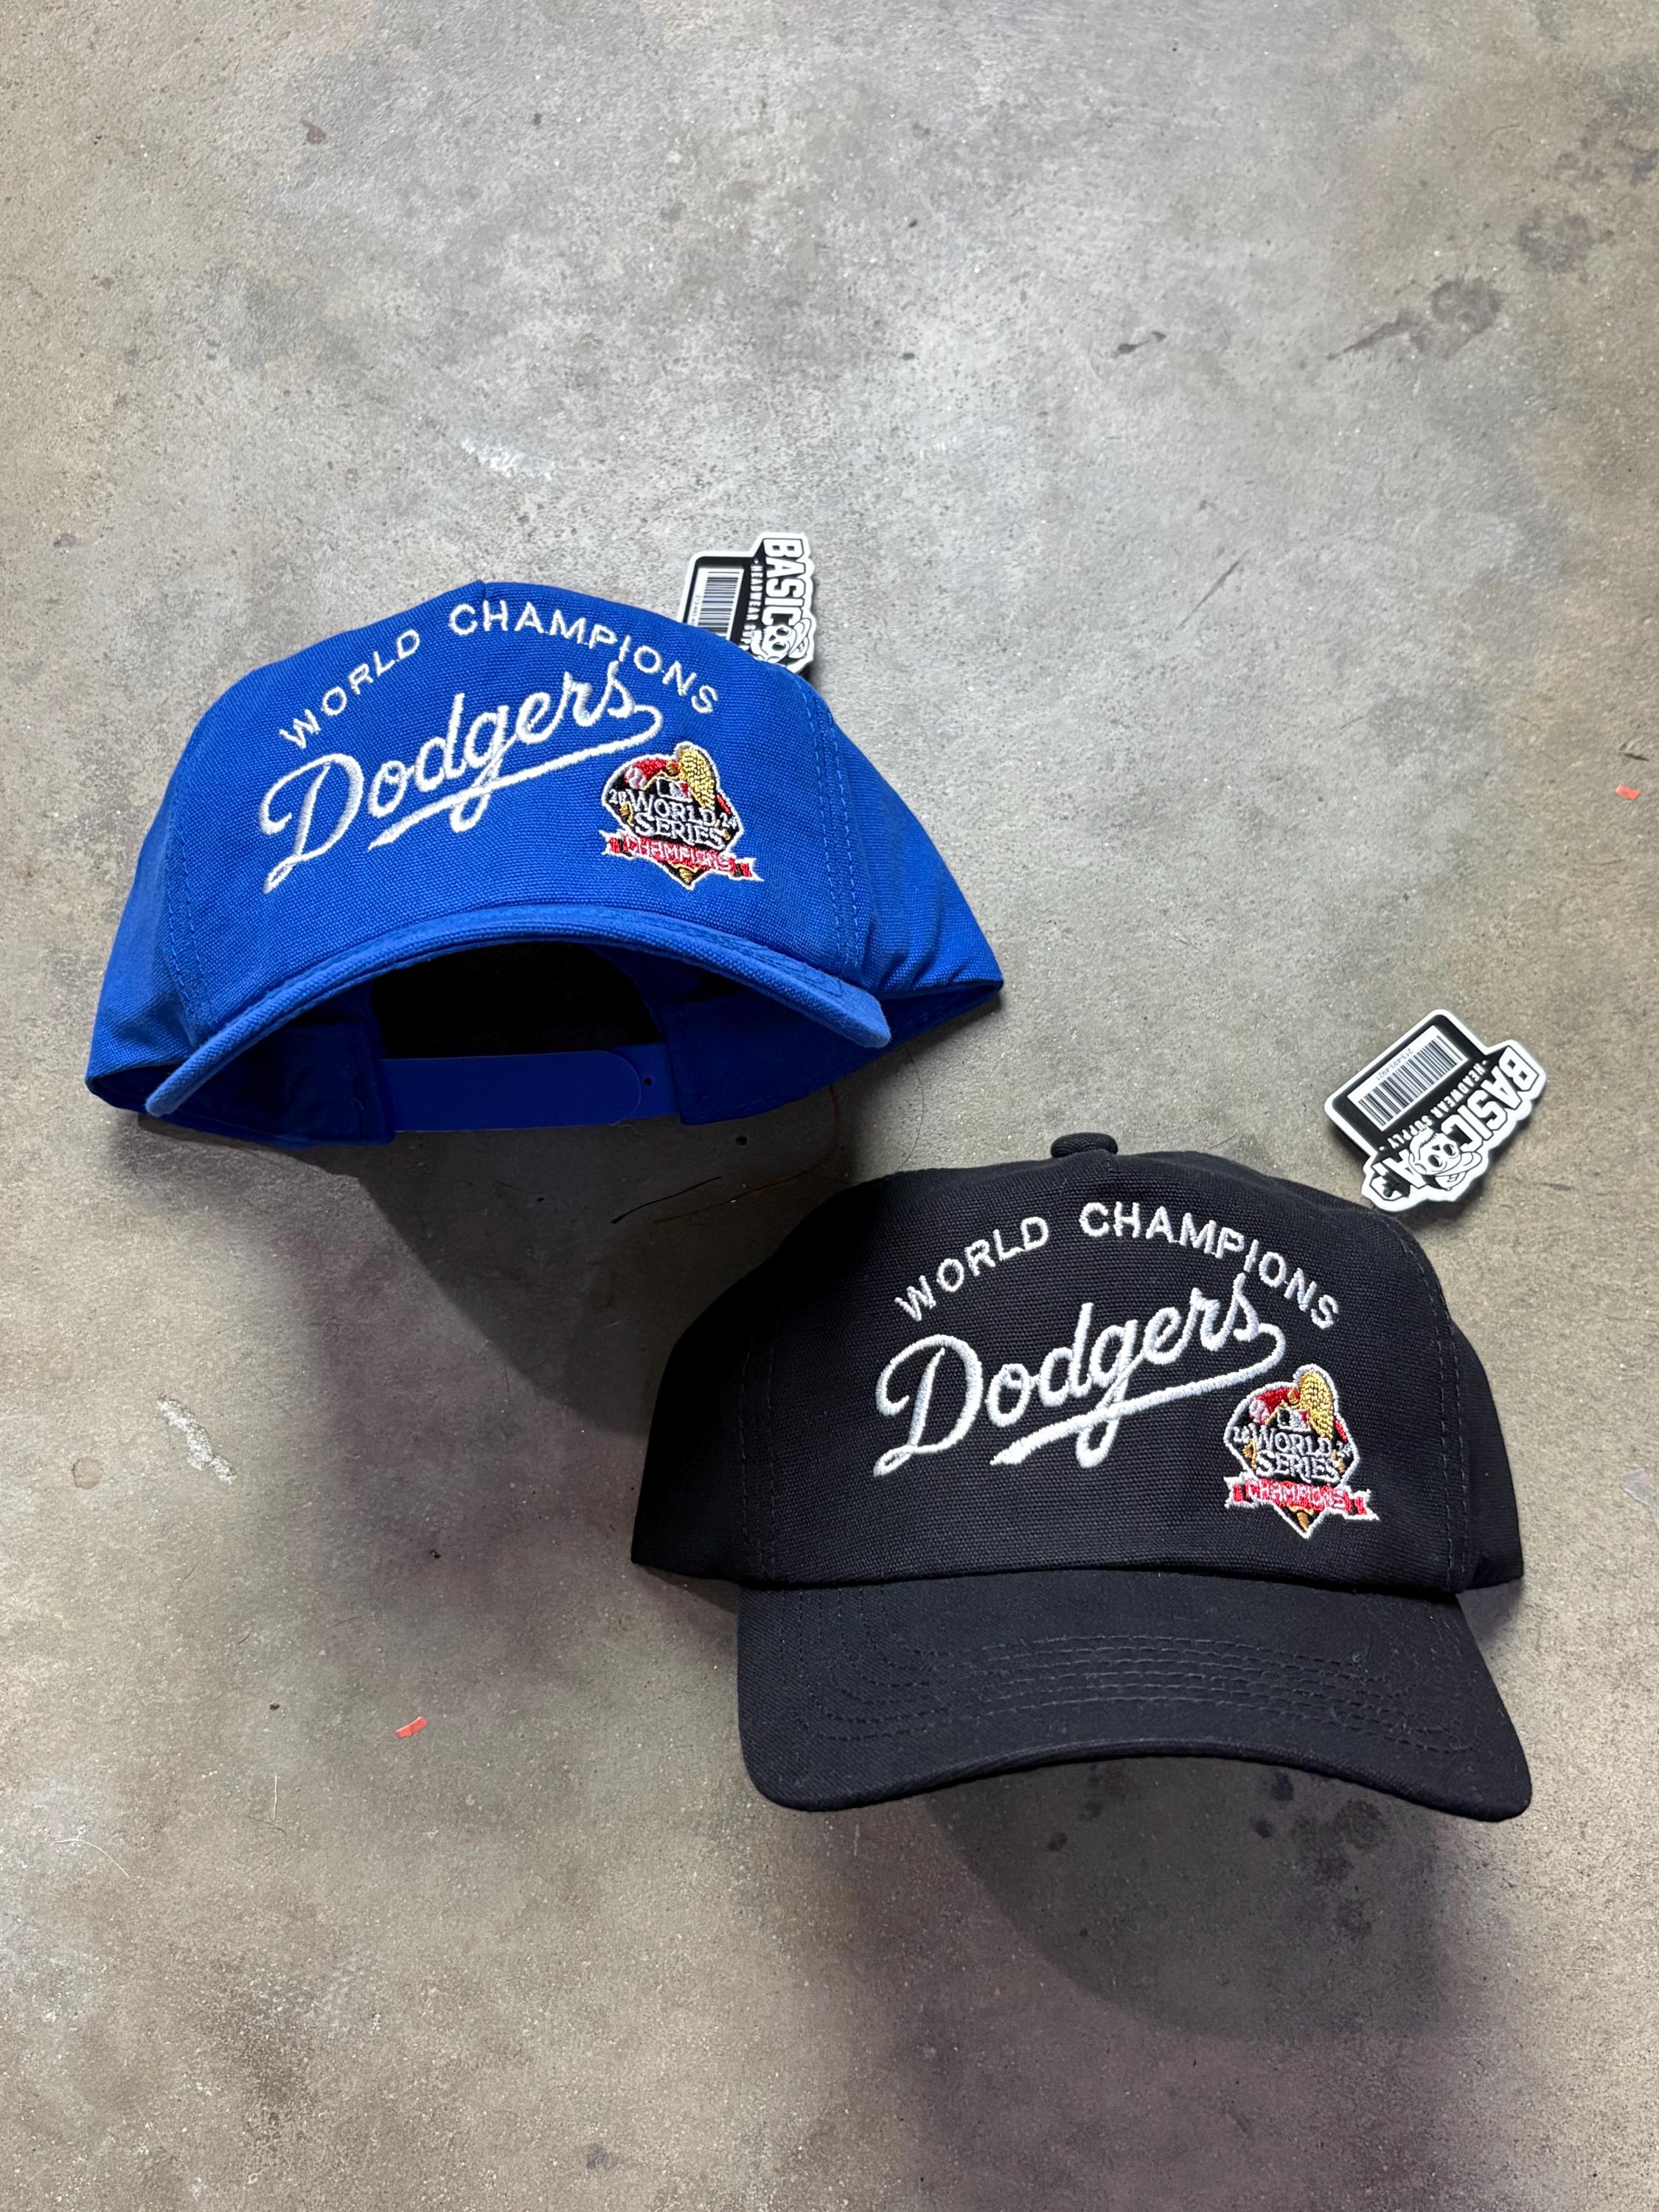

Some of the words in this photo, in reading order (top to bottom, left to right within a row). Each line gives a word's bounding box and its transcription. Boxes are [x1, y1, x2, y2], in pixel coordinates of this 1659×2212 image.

[746, 565, 763, 621] HEADWEAR
[762, 538, 806, 626] BASIC
[279, 629, 420, 749] WORLD
[448, 600, 719, 714] CHAMPIONS
[259, 661, 662, 894] Dodgers
[627, 789, 717, 826] WORLD
[635, 813, 726, 849] SERIES
[1430, 1062, 1486, 1119] HEADWEAR
[1441, 1045, 1540, 1154] BASIC
[1387, 1114, 1433, 1150] SUPPLY
[894, 1217, 1049, 1322] WORLD
[1079, 1201, 1339, 1329] CHAMPIONS
[873, 1273, 1286, 1475] Dodgers
[1248, 1423, 1333, 1457] WORLD
[1256, 1450, 1340, 1484] SERIES
